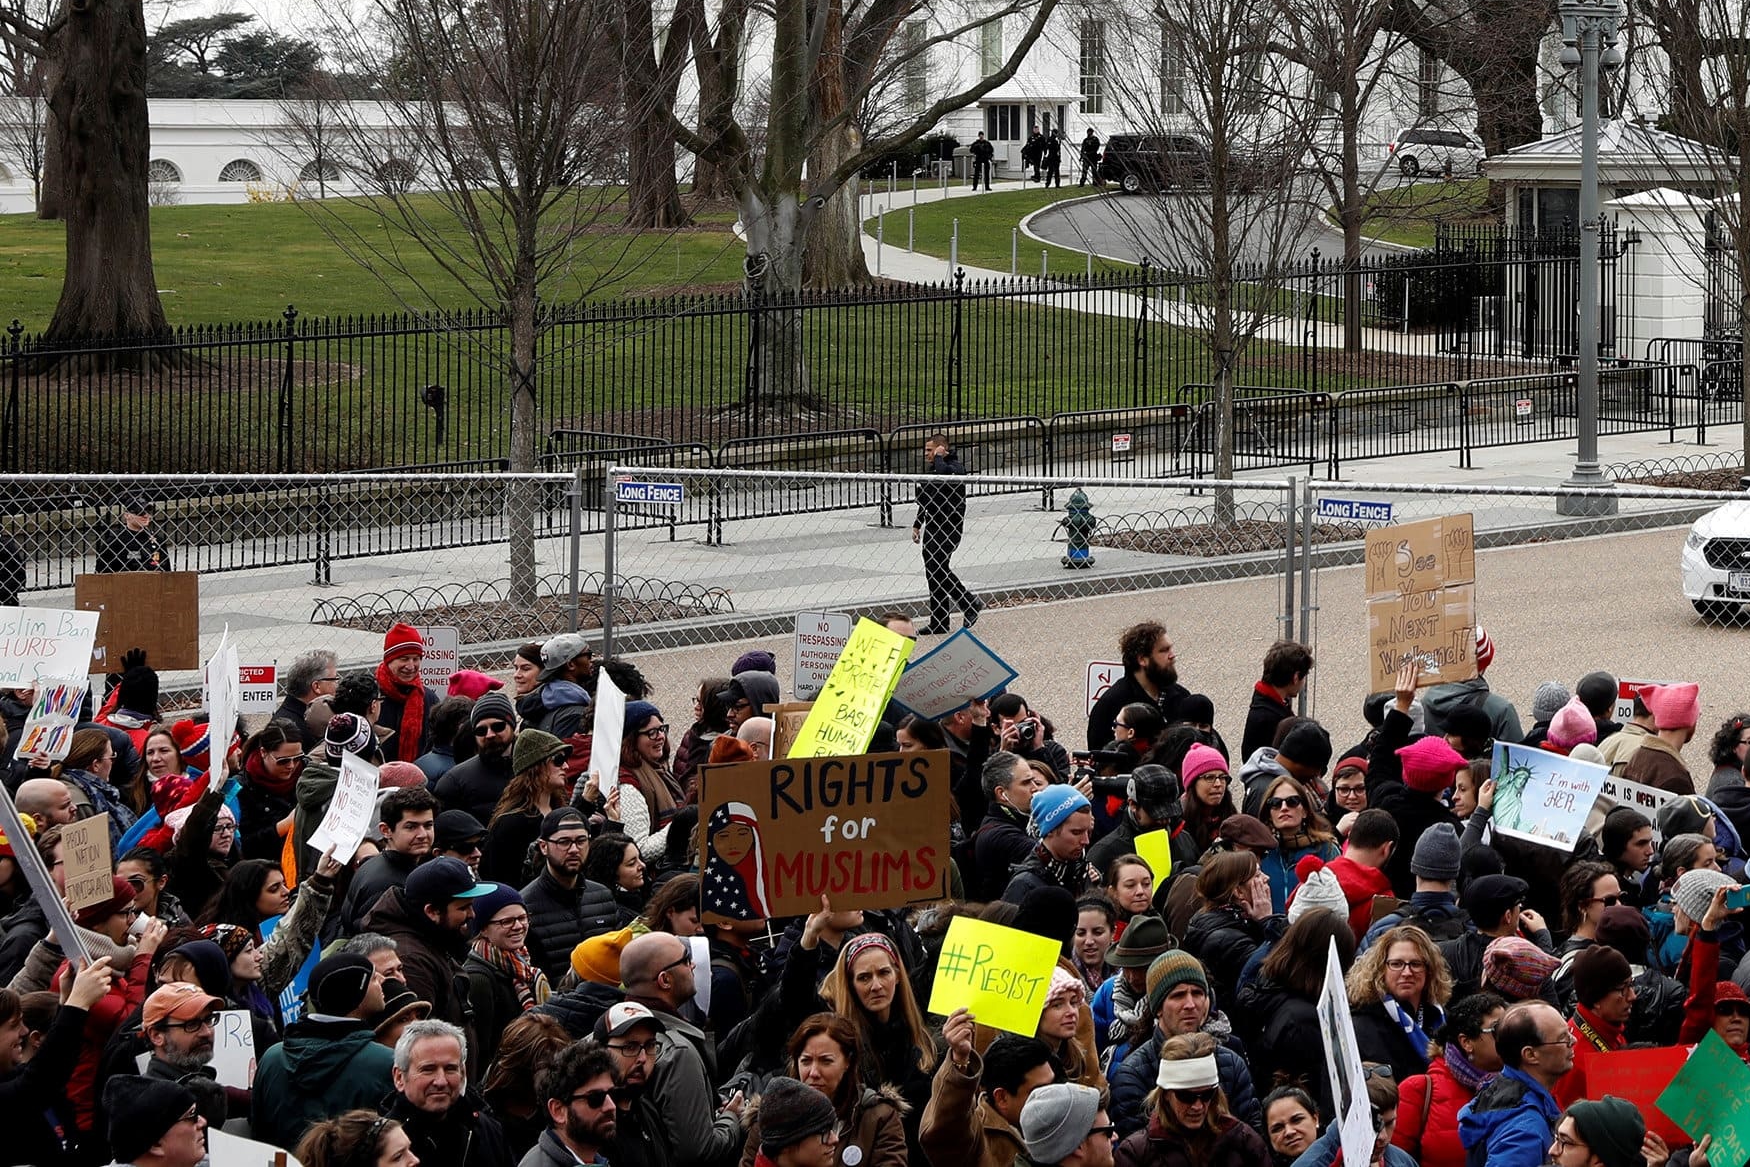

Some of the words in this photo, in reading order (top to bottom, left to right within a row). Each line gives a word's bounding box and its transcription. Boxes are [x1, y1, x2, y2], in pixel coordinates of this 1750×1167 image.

[619, 484, 646, 499] LONG
[647, 485, 680, 501] FENCE
[1319, 500, 1350, 517] LONG
[1352, 503, 1389, 520] FENCE
[0, 610, 46, 637] uslim
[57, 612, 90, 637] Ban
[818, 622, 829, 633] NO
[799, 634, 847, 647] TRESPASSING
[421, 650, 455, 661] PASSING
[801, 651, 838, 661] AUTHORIZE
[419, 667, 451, 676] HORIZED
[801, 661, 834, 671] PERSONN
[797, 683, 813, 691] HARD
[242, 691, 273, 702] ENTER
[1618, 707, 1631, 717] DO
[771, 757, 931, 820] RIGHTS
[1545, 772, 1570, 787] I'm
[1571, 780, 1591, 794] with
[1623, 787, 1632, 801] IS
[1636, 790, 1656, 808] OPEN
[819, 815, 877, 844] for
[774, 846, 937, 899] MUSLIMS
